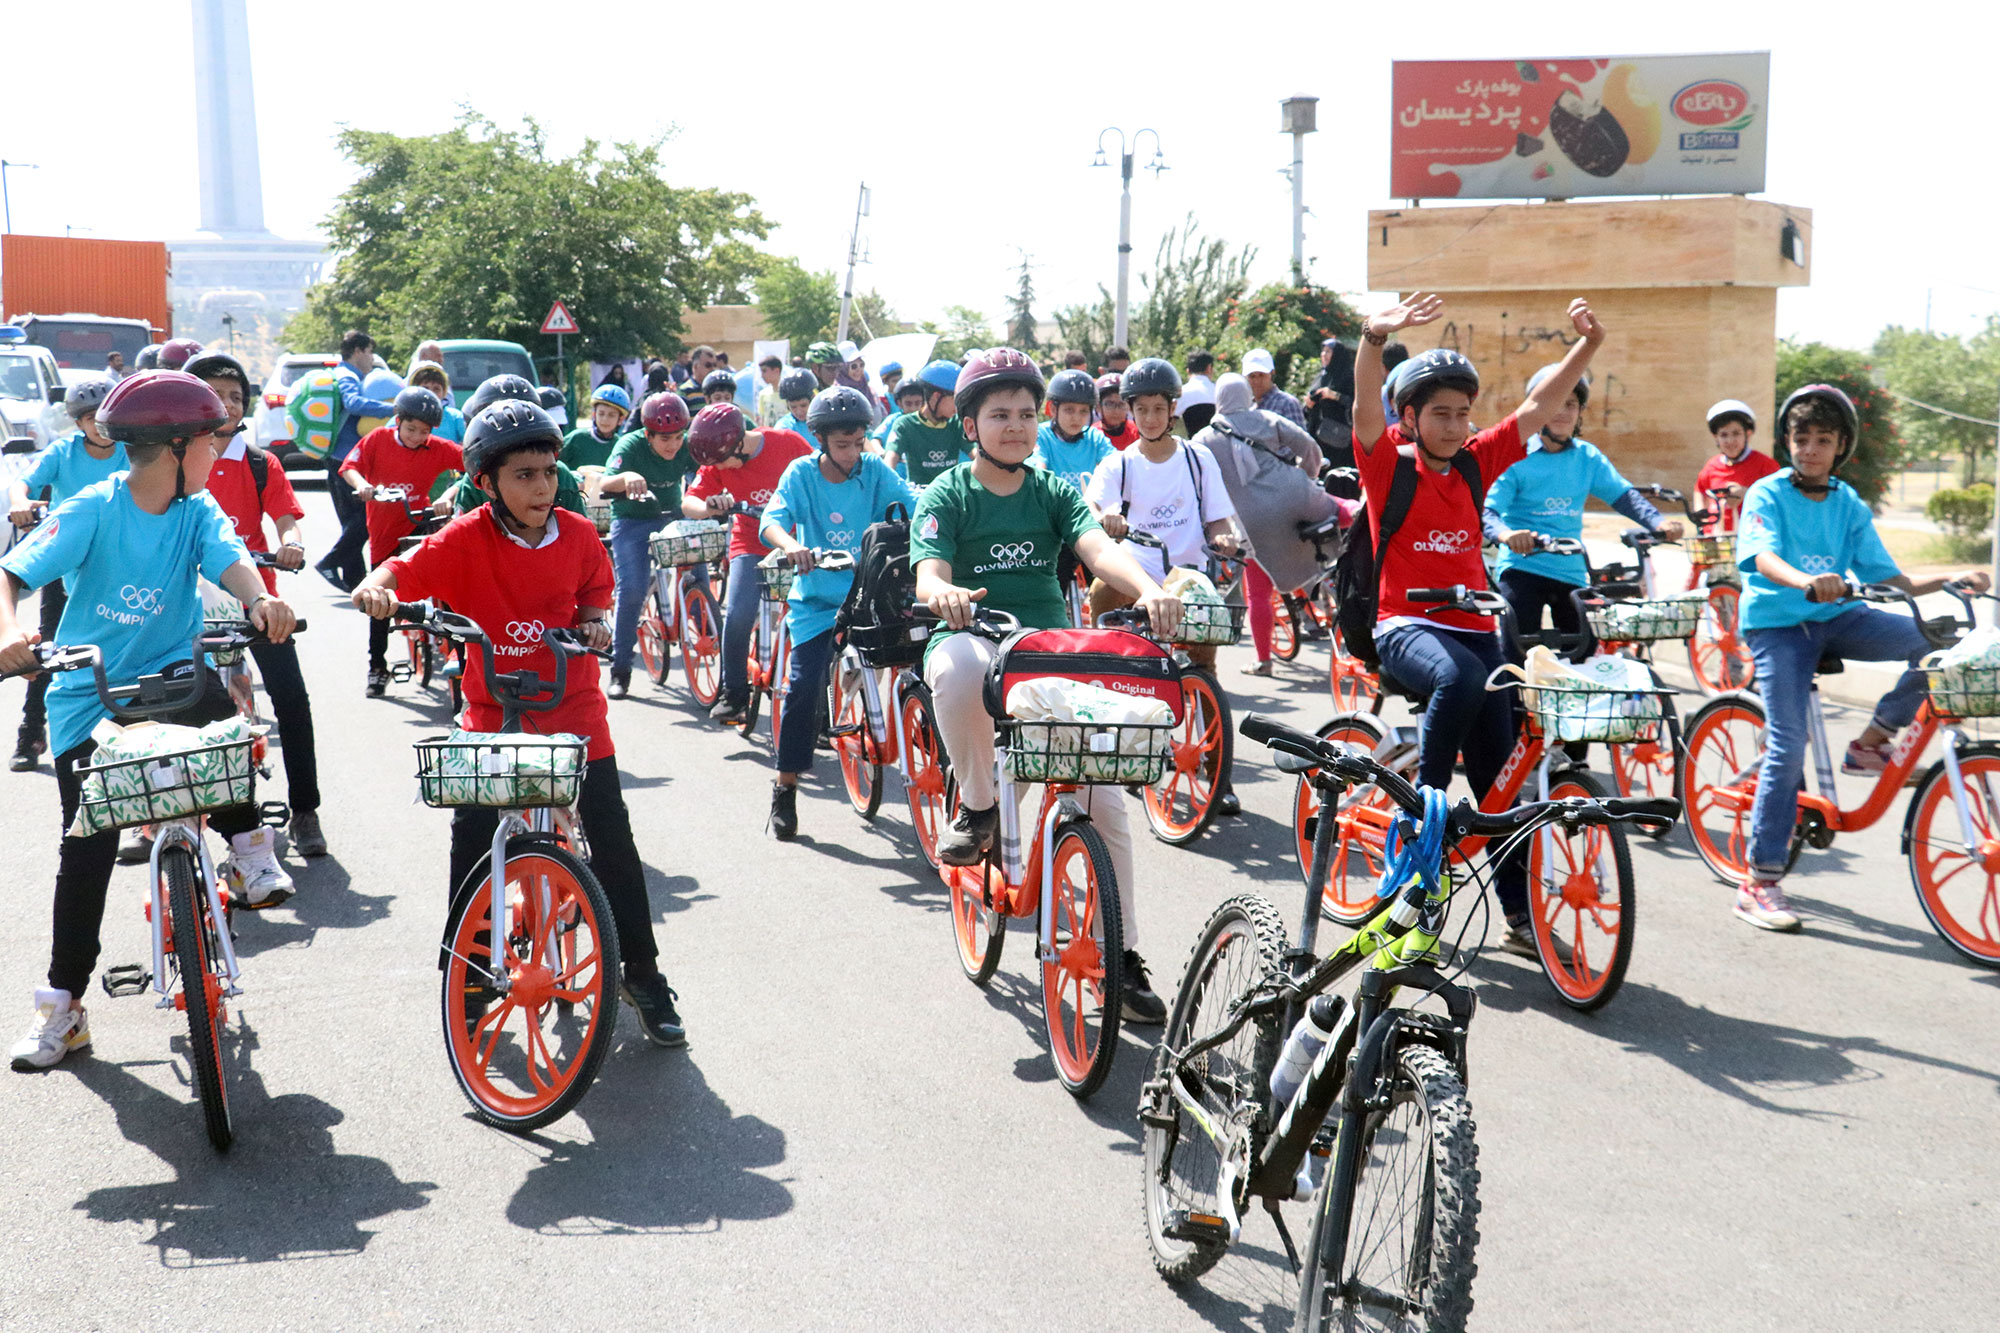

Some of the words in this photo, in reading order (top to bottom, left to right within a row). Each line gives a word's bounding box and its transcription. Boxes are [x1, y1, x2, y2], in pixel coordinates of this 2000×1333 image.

[1456, 79, 1490, 99] پارک
[1400, 98, 1522, 130] پردیسان
[1137, 521, 1173, 531] OLYMPIC
[1174, 517, 1190, 527] DAY
[1413, 541, 1460, 554] OLYMPIC
[973, 559, 1028, 574] OLYMPIC
[96, 603, 146, 626] OLYMPI
[492, 643, 539, 658] LYMPIC
[1111, 681, 1156, 696] Original
